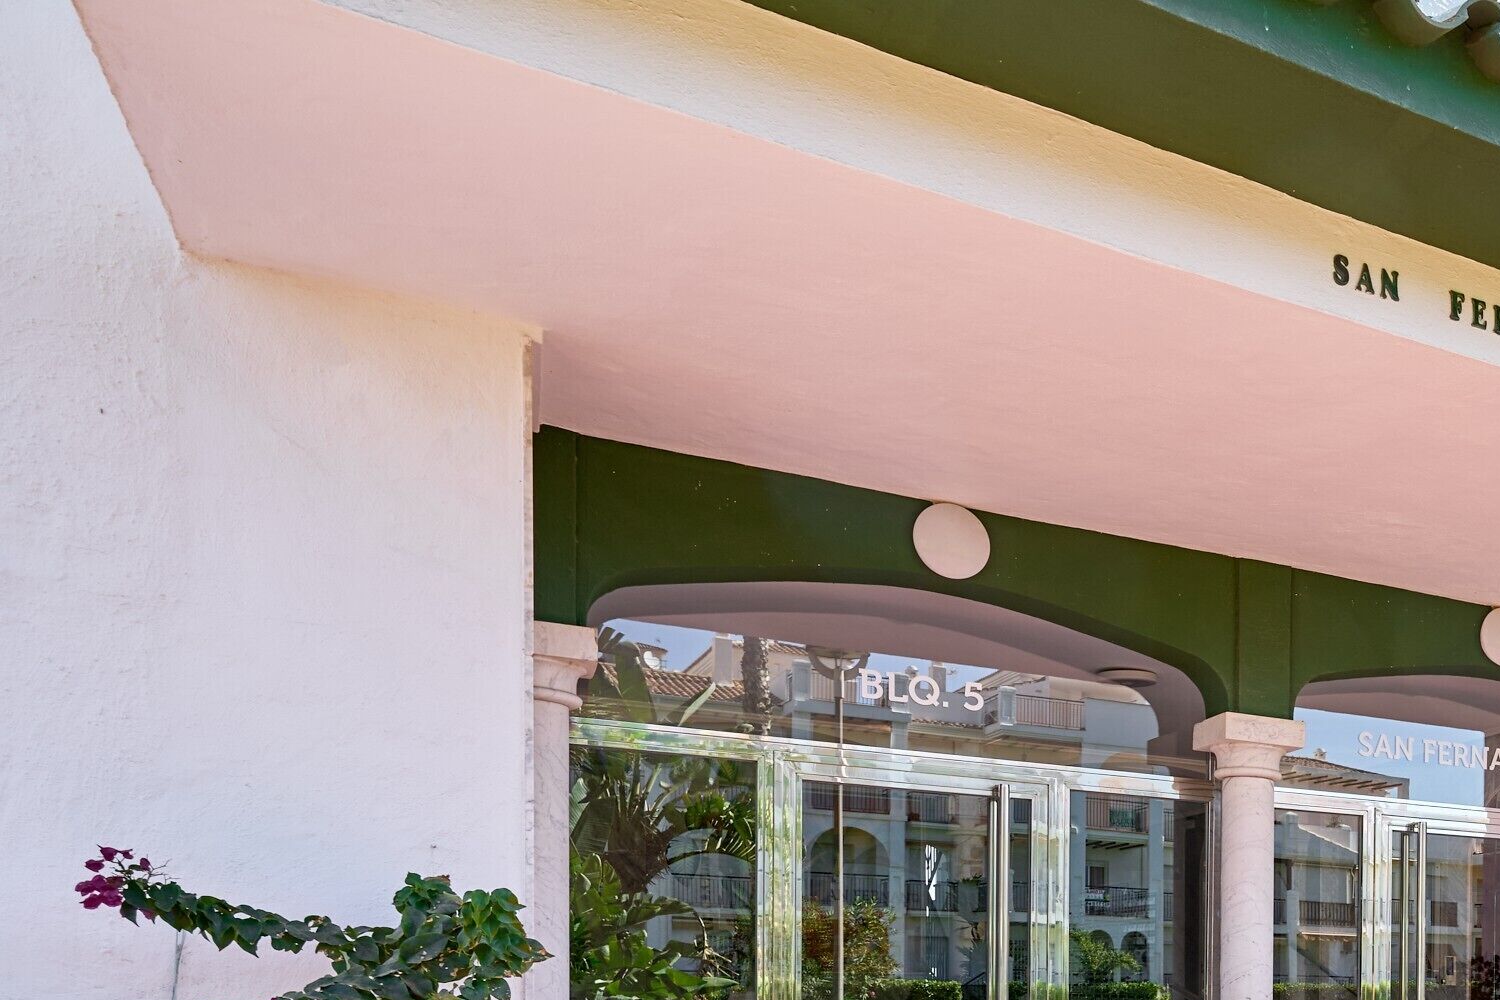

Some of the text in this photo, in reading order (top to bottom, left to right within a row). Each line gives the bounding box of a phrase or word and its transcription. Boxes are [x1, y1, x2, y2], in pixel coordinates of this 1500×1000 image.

[1332, 254, 1400, 302] SAN
[859, 668, 985, 711] BLQ. 5
[1358, 731, 1415, 761] SAN
